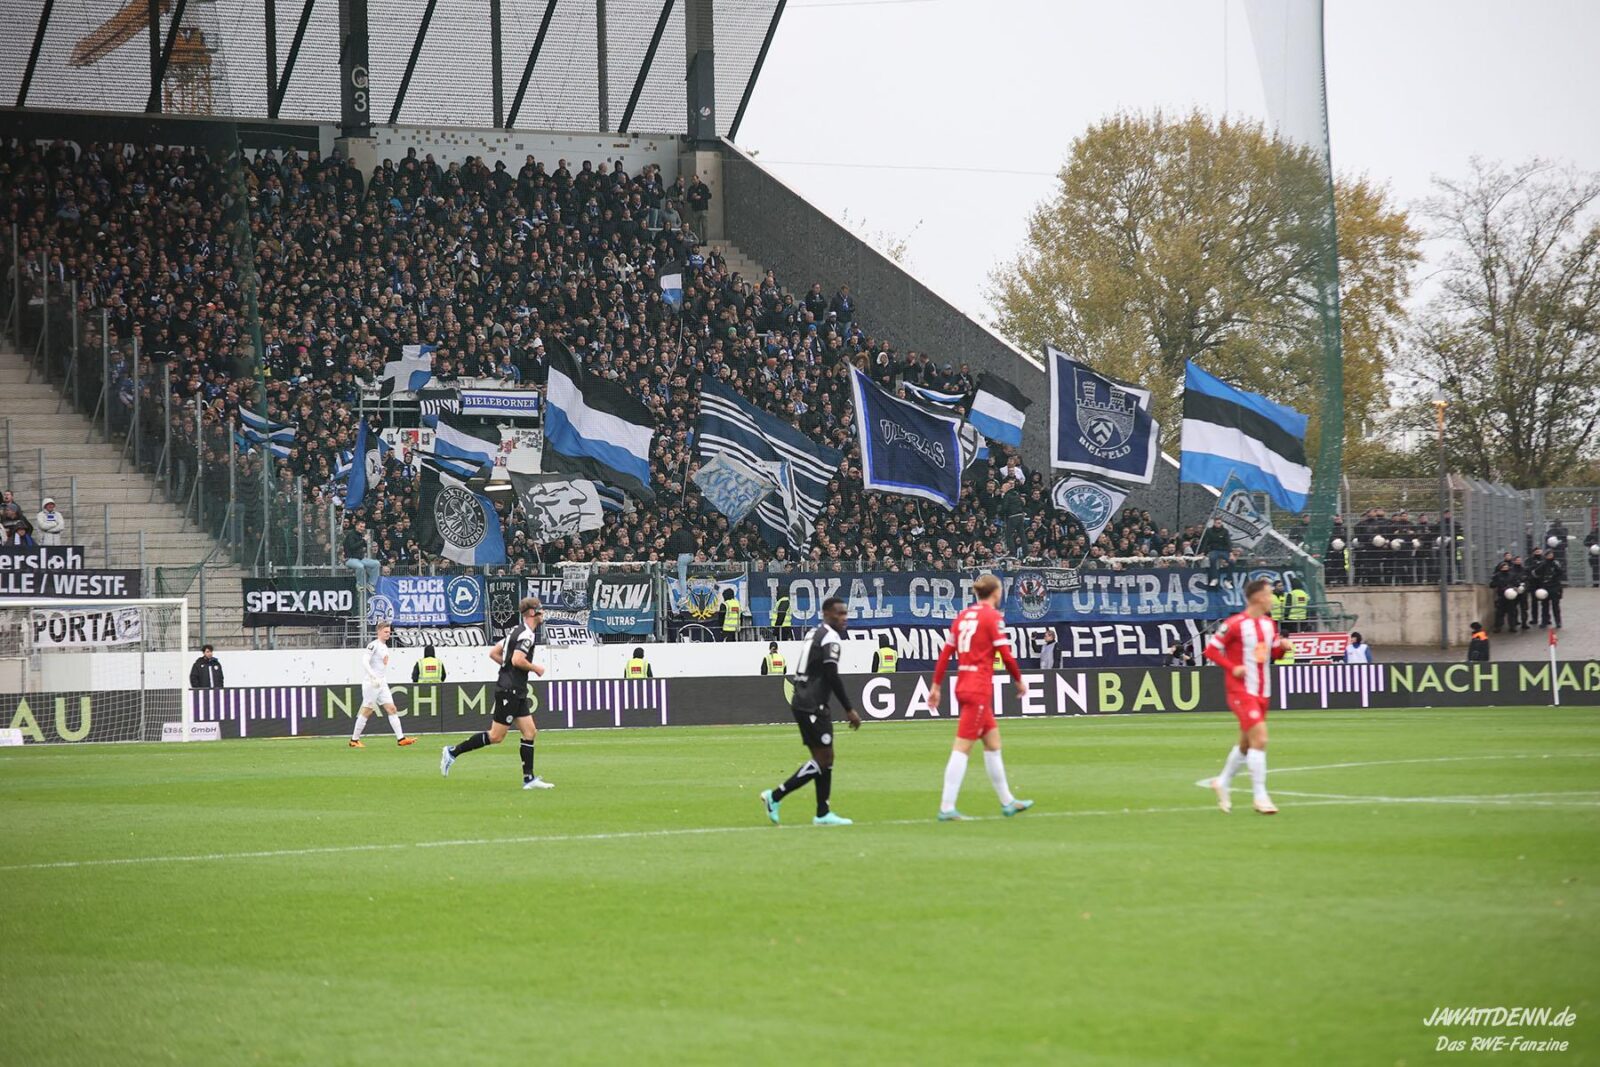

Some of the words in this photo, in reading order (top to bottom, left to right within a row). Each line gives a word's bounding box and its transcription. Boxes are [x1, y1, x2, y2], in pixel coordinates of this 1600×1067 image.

[354, 91, 367, 112] 3
[464, 396, 536, 408] BIELEBORNER
[880, 419, 946, 469] ULRAS
[53, 574, 128, 596] WESTF.
[398, 579, 445, 593] BLOCK
[1072, 573, 1209, 615] ULTRAS
[246, 589, 353, 613] SPEXARD
[399, 594, 446, 612] ZWO
[767, 577, 894, 619] LOKAL
[909, 577, 1014, 619] CRE
[33, 611, 118, 643] PORTA
[606, 616, 636, 626] ULTRAS
[1391, 664, 1499, 693] NACH
[326, 685, 438, 719] NCH
